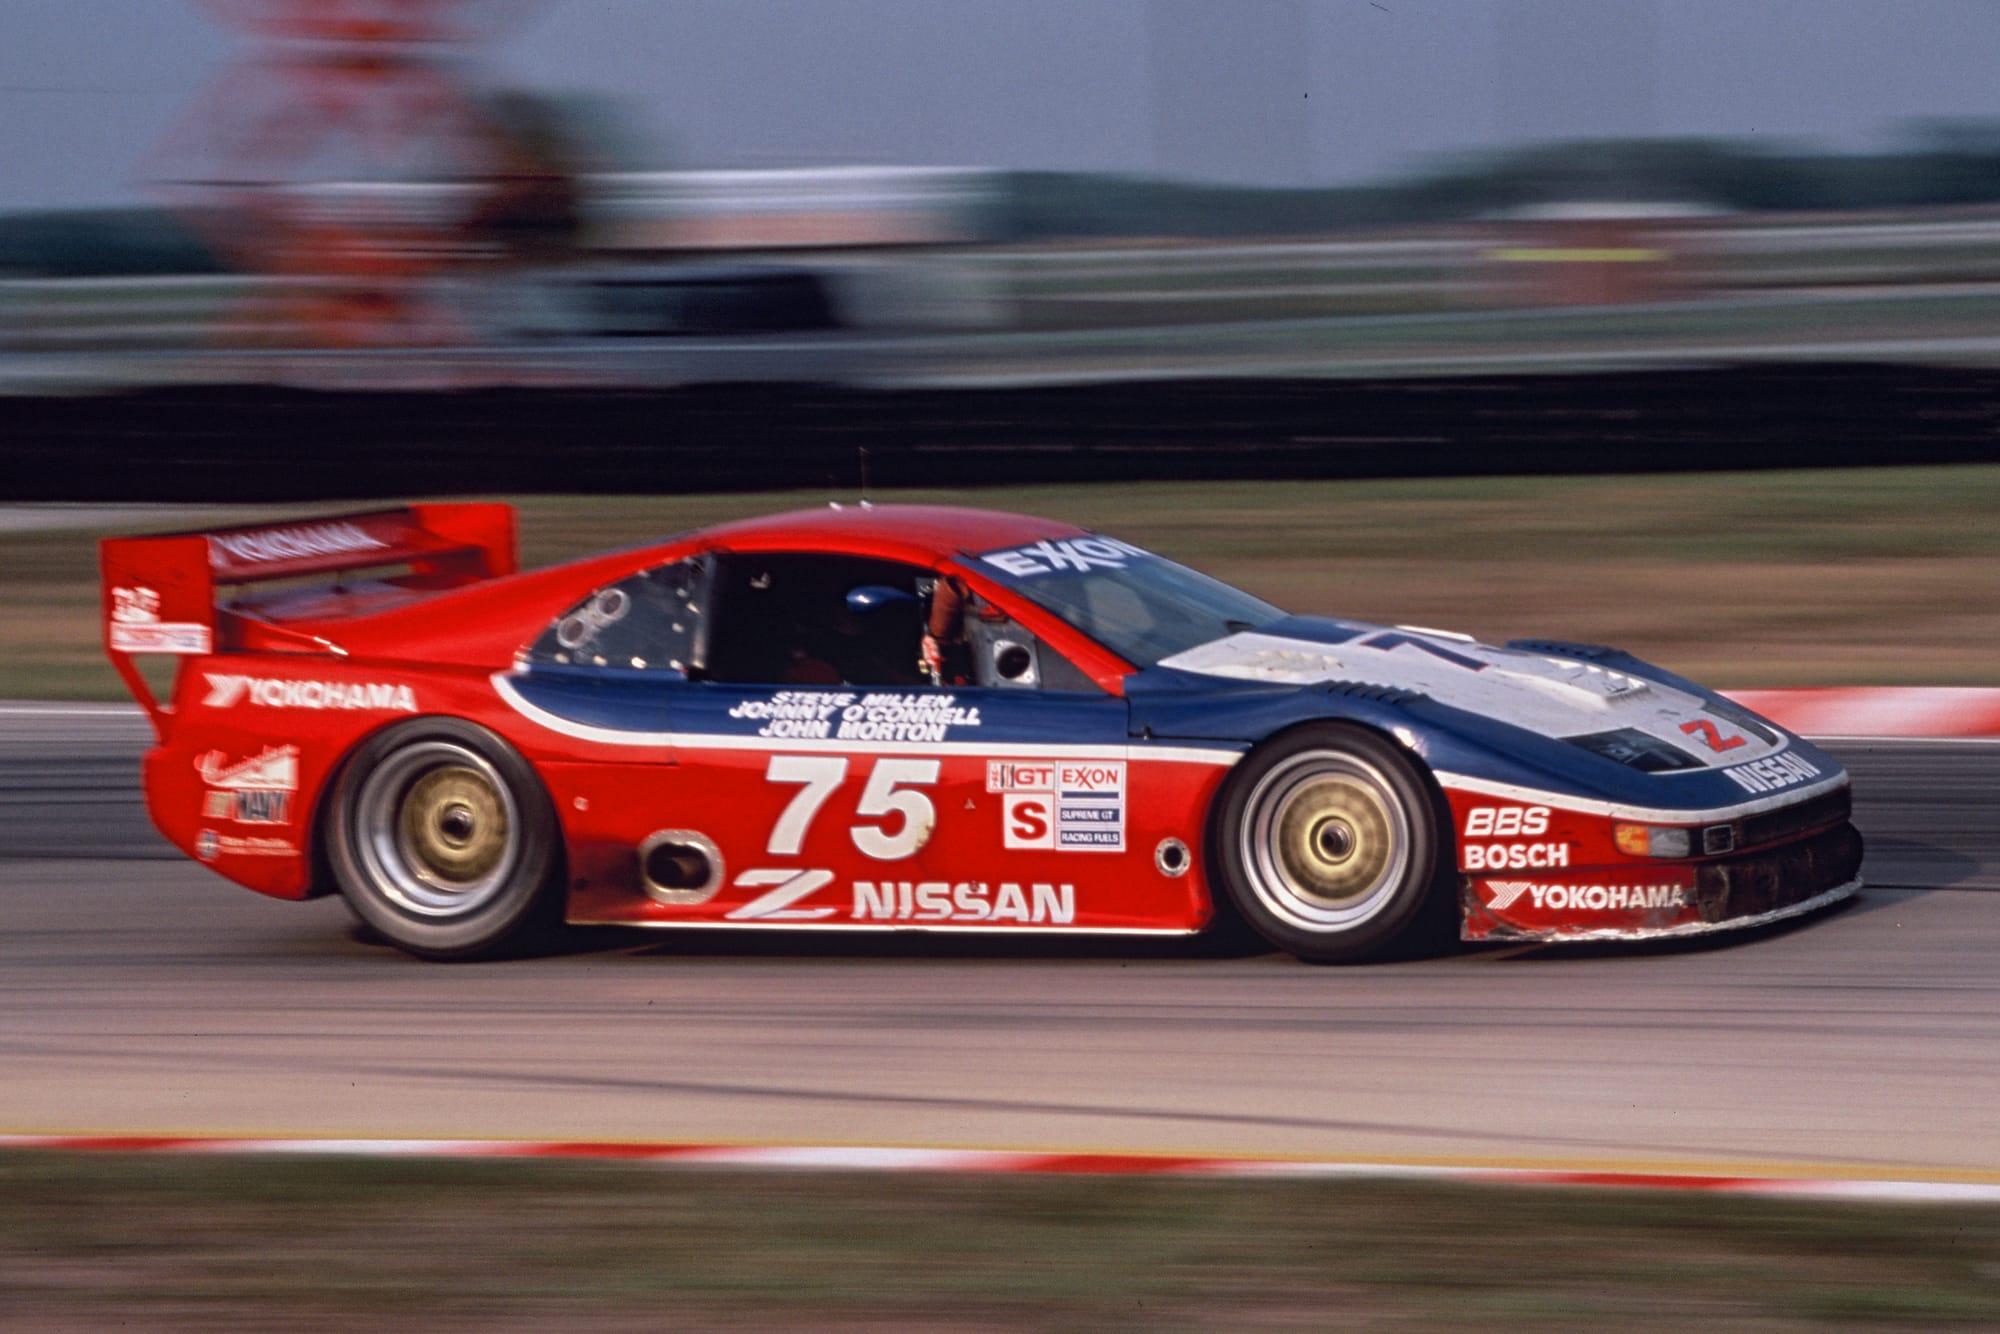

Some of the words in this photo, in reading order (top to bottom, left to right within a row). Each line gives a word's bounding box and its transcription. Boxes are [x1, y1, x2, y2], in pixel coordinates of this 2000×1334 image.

[981, 535, 1152, 577] EXXON
[247, 677, 418, 712] YOKOHAMA
[772, 691, 856, 706] STEVE
[861, 693, 956, 708] MILLEN
[729, 701, 837, 720] JOHNNY
[842, 705, 981, 726] O'CONNELL
[759, 720, 831, 739] JOHN
[837, 722, 947, 741] MORTON
[1014, 767, 1053, 785] GT
[1062, 766, 1118, 790] EXXON
[1722, 750, 1821, 793] NISSAN
[766, 755, 942, 861] 75
[1011, 801, 1047, 840] S
[1062, 810, 1099, 820] SUPREME
[1464, 807, 1550, 836] BBS
[1062, 832, 1093, 842] RACING
[1094, 832, 1118, 842] FUELS
[1465, 843, 1568, 869] BOSCH
[851, 882, 1074, 924] NISSAN
[1529, 884, 1688, 909] YOKOHAMA
